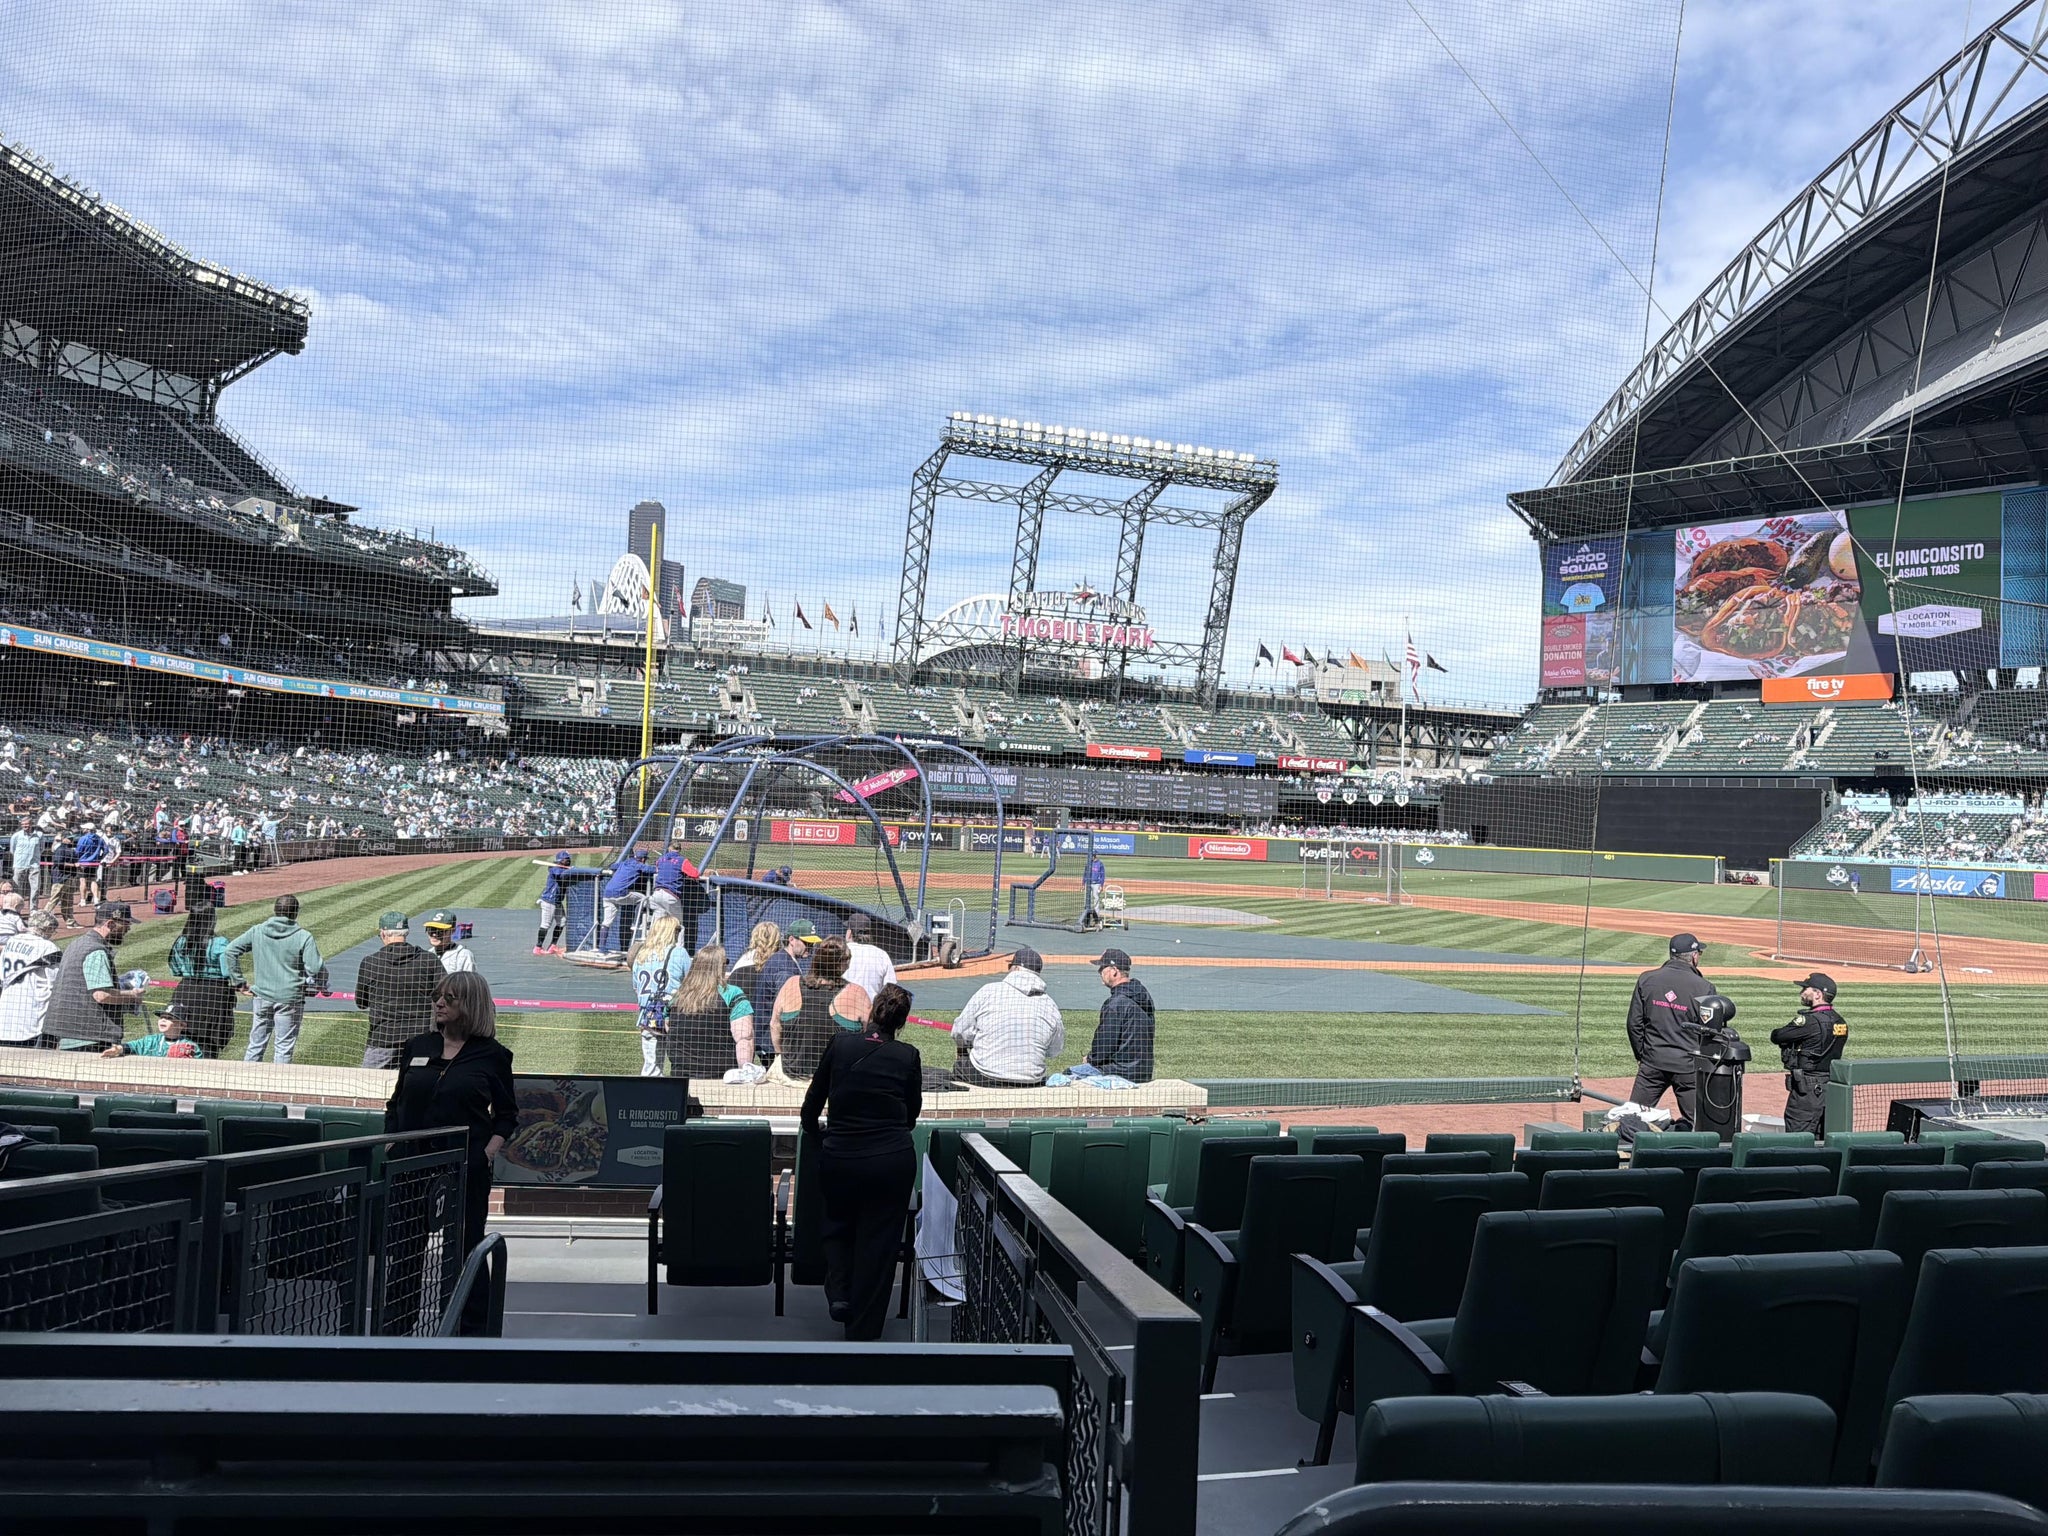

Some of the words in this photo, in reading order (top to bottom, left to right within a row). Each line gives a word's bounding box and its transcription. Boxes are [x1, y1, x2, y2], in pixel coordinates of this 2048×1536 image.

[1562, 552, 1606, 564] J-ROD
[1876, 552, 1890, 568] EL
[1895, 543, 1984, 566] RINCONSITO
[1560, 562, 1608, 574] SQUAD
[1898, 566, 1928, 578] ASADA
[1930, 564, 1960, 576] TACOS
[1016, 591, 1066, 608] SEATTLE
[1094, 593, 1146, 622] MARINERS
[1908, 612, 1950, 620] LOCATION
[1000, 614, 1096, 643] T-MOBILE
[1102, 625, 1155, 648] PARK
[34, 634, 52, 646] SUN
[54, 638, 90, 652] CRUISER
[1544, 651, 1582, 660] DONATION
[150, 655, 164, 665] SUN
[166, 658, 194, 672] CRUISER
[244, 672, 256, 682] SUN
[257, 675, 283, 687] CRUISER
[1807, 679, 1828, 690] fire
[1832, 678, 1844, 688] tv
[350, 687, 366, 696] SUN
[368, 690, 400, 700] CRUISER
[457, 700, 472, 708] SUN
[473, 702, 501, 711] CRUISER
[928, 771, 952, 783] RIGHT
[954, 772, 963, 783] TO
[966, 773, 986, 784] YOUR
[794, 828, 835, 837] BECU
[369, 842, 395, 850] LEXUS
[483, 838, 504, 850] STIHL
[1208, 844, 1246, 852] Nintendo
[1300, 847, 1349, 859] KeyBank
[1897, 872, 1966, 894] Alaska
[433, 913, 444, 921] S
[5, 942, 34, 956] ALEIGH
[639, 969, 669, 994] 29
[618, 1110, 627, 1119] EL
[629, 1110, 678, 1120] RINCONSITO
